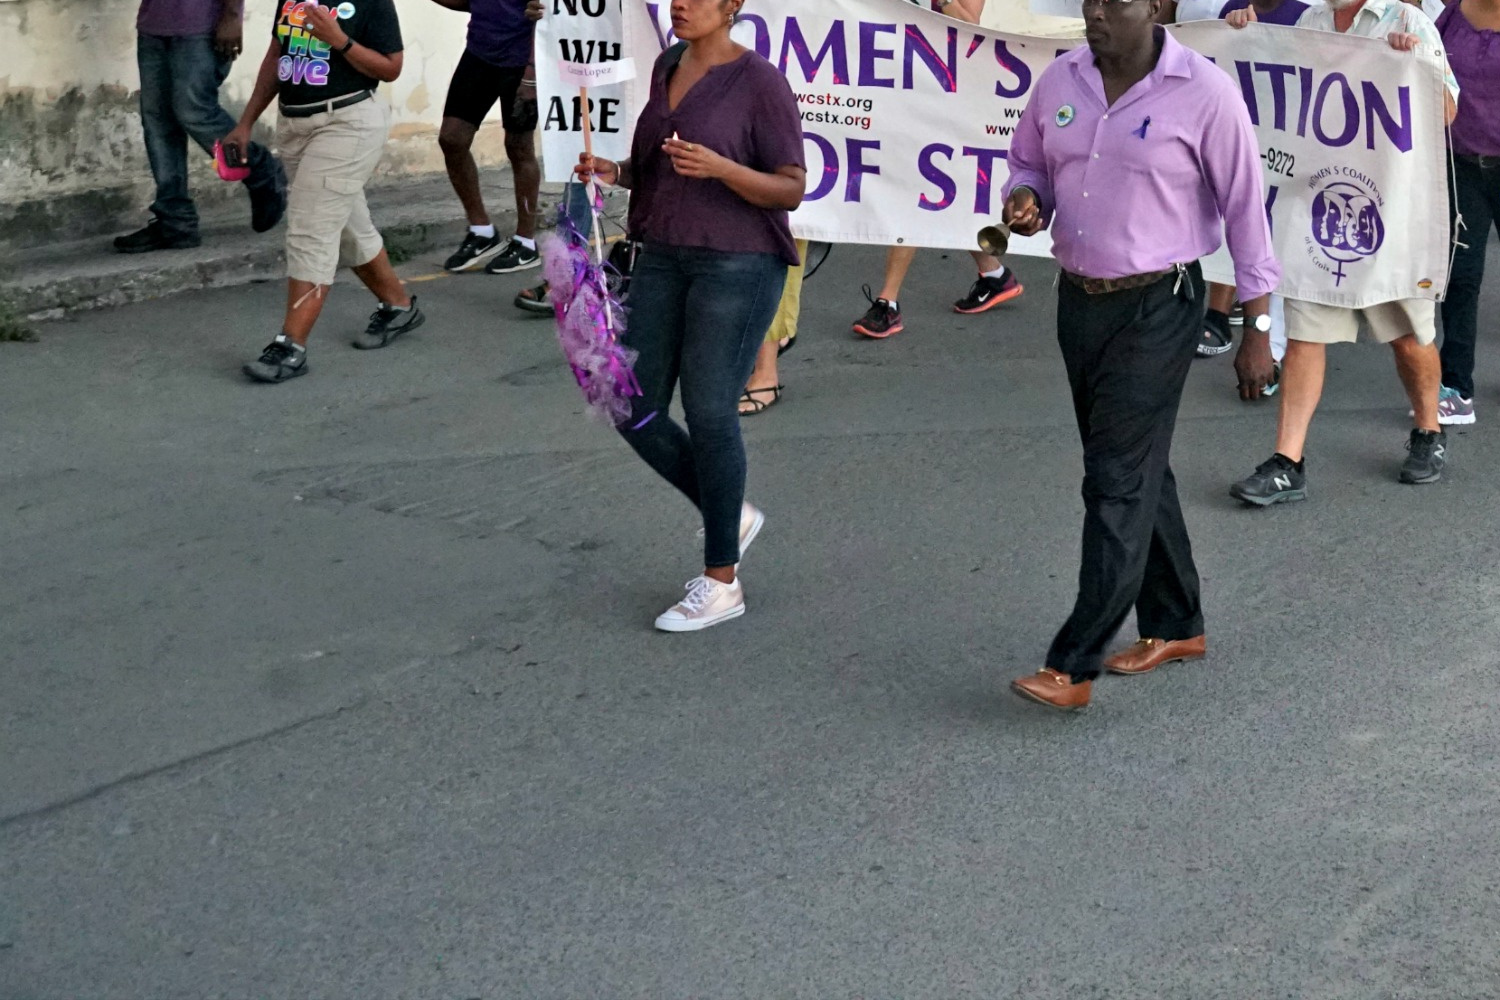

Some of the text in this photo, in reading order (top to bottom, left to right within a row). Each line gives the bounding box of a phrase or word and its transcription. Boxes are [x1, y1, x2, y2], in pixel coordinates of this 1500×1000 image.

[584, 66, 612, 78] Lopez
[646, 2, 1413, 154] OMEN'S ITION
[544, 95, 620, 133] ARE
[802, 131, 880, 203] OF
[1342, 166, 1385, 208] COALITION
[1312, 256, 1330, 273] Croix
